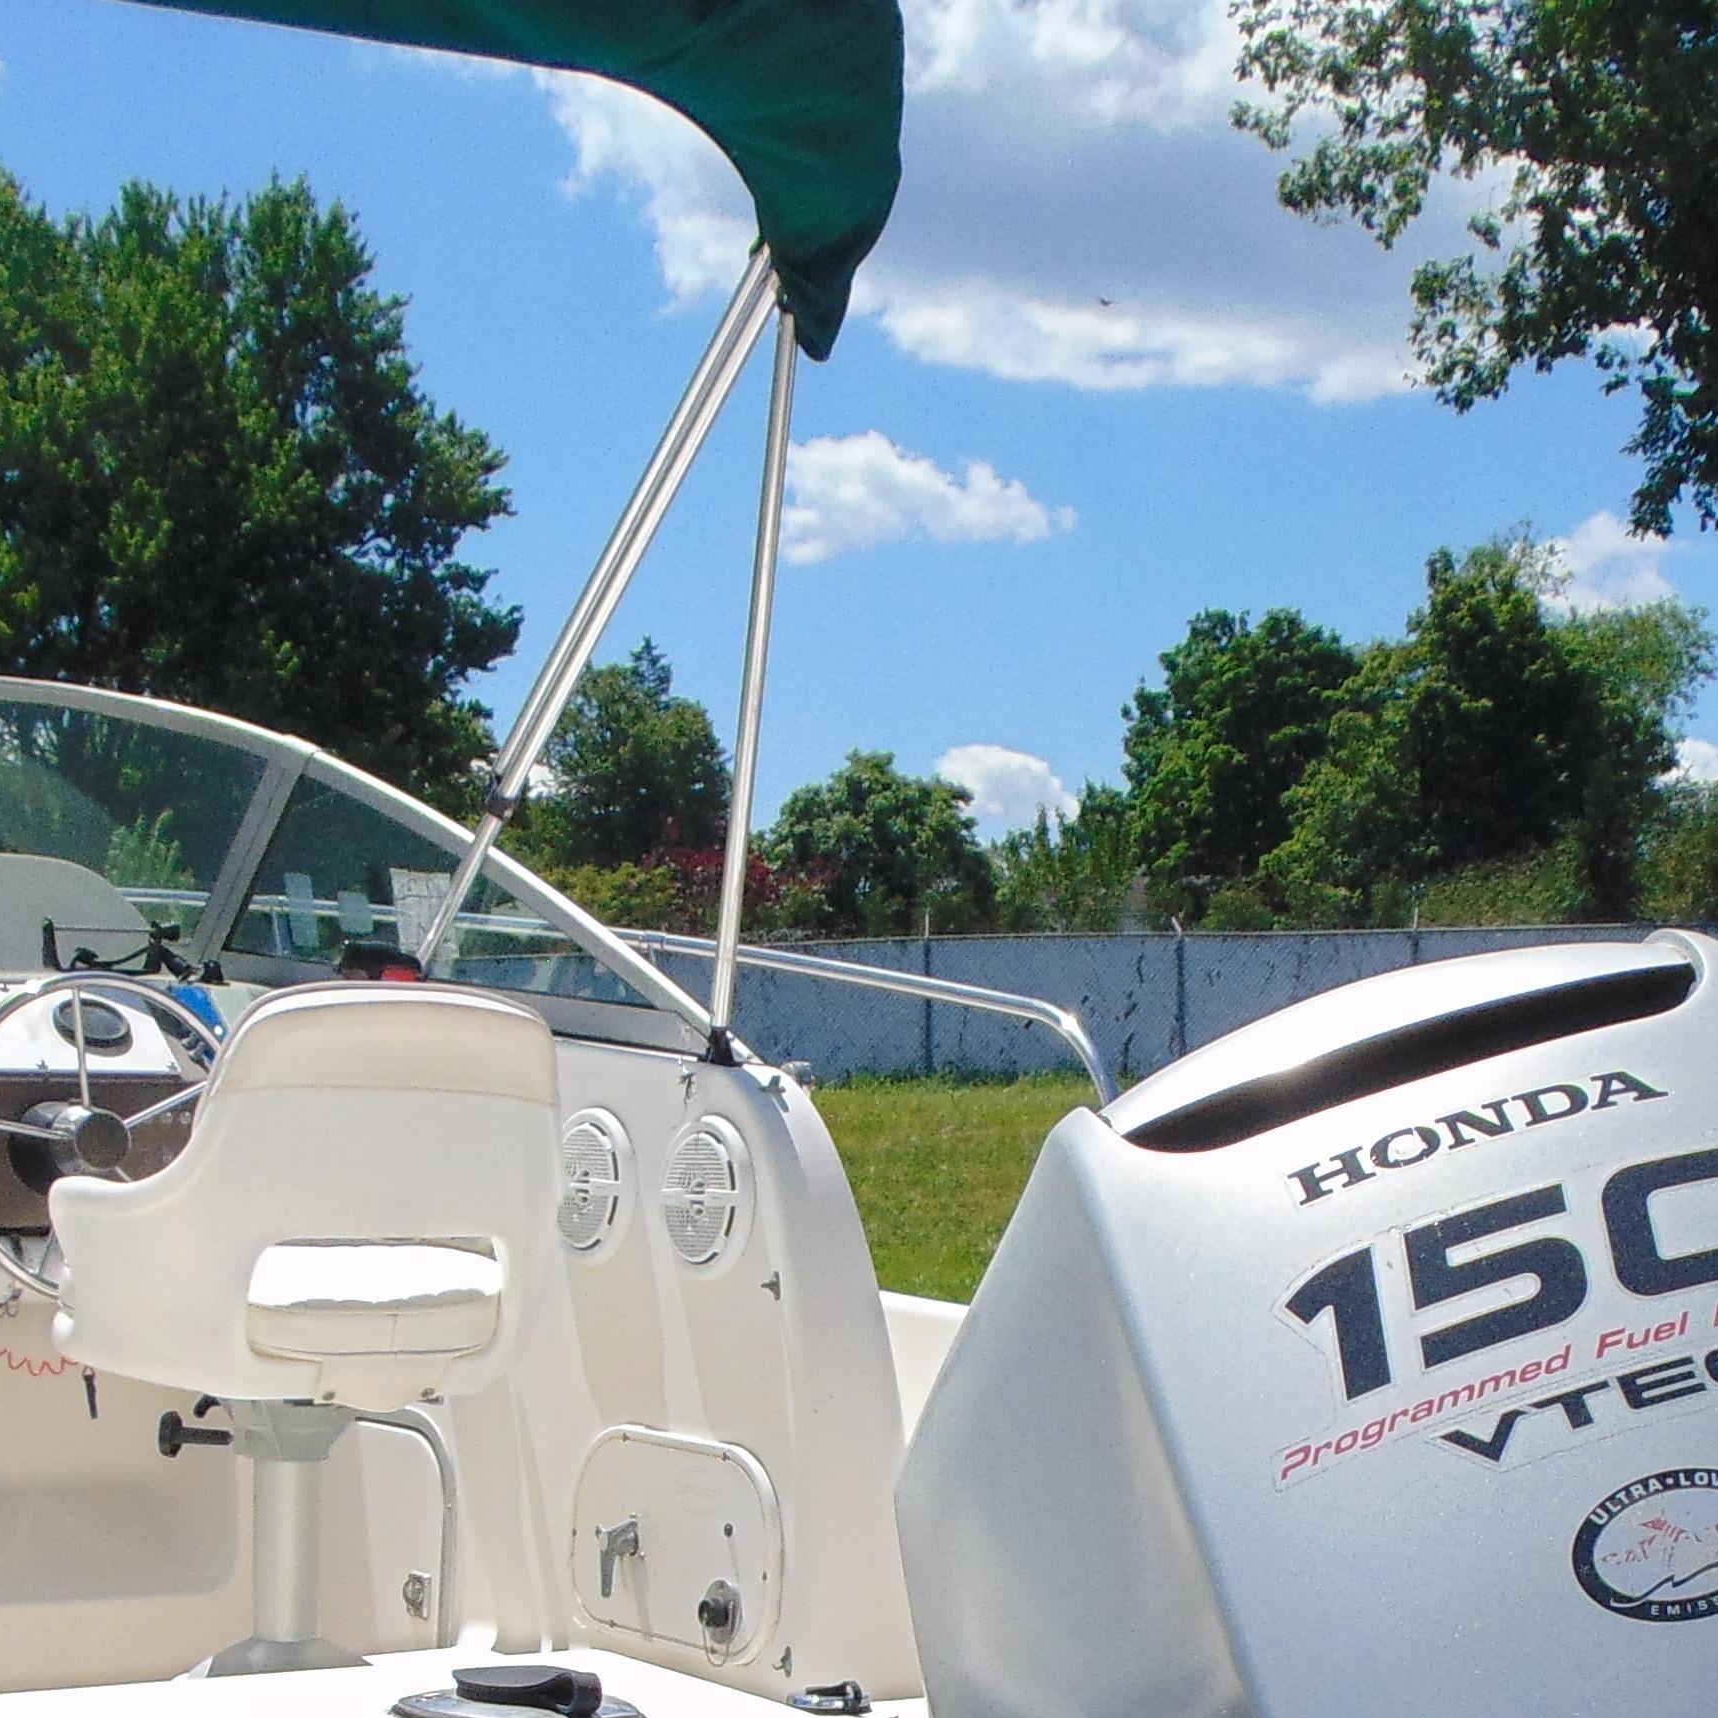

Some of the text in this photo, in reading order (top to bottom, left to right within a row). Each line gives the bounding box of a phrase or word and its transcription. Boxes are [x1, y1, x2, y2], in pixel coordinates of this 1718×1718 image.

[1287, 1071, 1669, 1206] HONDA
[1280, 1343, 1573, 1482] Programmed
[1595, 1310, 1690, 1359] Fuel
